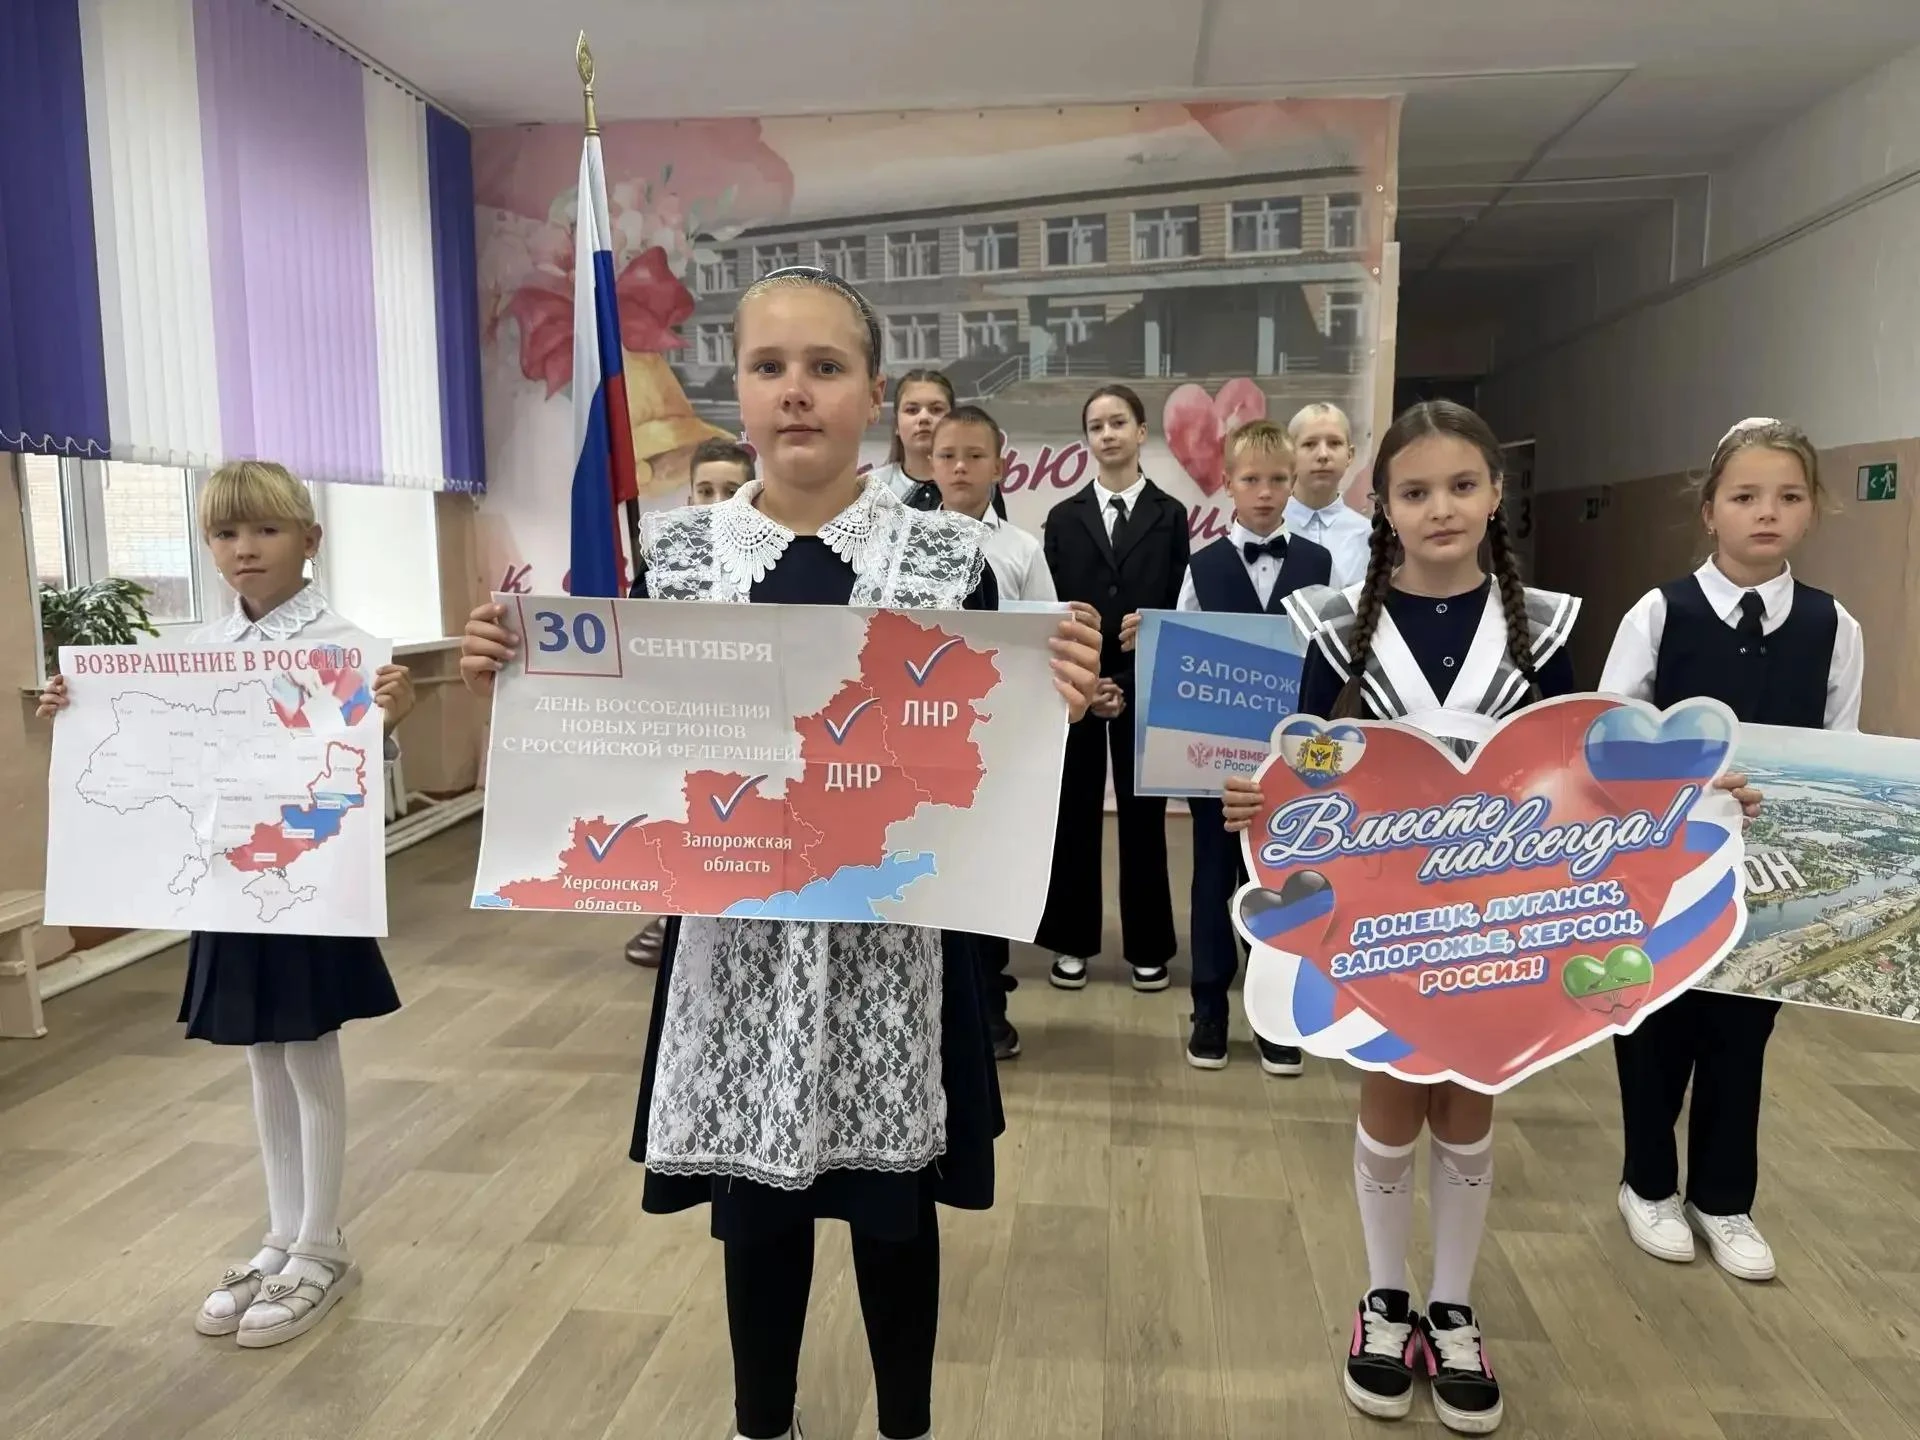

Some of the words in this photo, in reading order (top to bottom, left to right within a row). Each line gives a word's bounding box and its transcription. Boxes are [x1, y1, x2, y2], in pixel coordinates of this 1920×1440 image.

[535, 611, 606, 655] 30
[629, 637, 773, 662] СЕНТЯБРЯ
[75, 651, 237, 676] ВОЗВРАЩЕНИЕ
[244, 651, 256, 671] В
[263, 648, 362, 671] РОССИЮ
[1180, 655, 1300, 695] ЗАПОРОЖ
[534, 696, 590, 712] ДЕНЬ
[596, 697, 770, 719] ВОССОЕДИНЕНИЯ
[1177, 681, 1290, 715] ОБЛАСТЬ
[901, 701, 958, 726] ЛНР
[560, 718, 635, 736] НОВЫХ
[640, 719, 747, 739] РЕГИОНОВ
[521, 736, 661, 758] РОССИЙСКОЙ
[667, 742, 798, 761] ФЕДЕРАЦИЕЙ
[1215, 747, 1237, 759] МЫ
[825, 763, 882, 791] ДНР
[682, 831, 792, 850] Запорожская
[1261, 793, 1509, 863] Вместе
[1418, 785, 1697, 877] навсегда!
[703, 856, 771, 873] область
[562, 874, 659, 892] Херсонская
[574, 897, 642, 912] область
[1351, 904, 1480, 944] ДОНЕЦК,
[1483, 880, 1624, 922] ЛУГАНСК,
[1331, 930, 1514, 977] ЗАПОРОЖЬЕ,
[1519, 910, 1643, 949] ХЕРСОН,
[1419, 956, 1543, 994] РОССИЯ!
